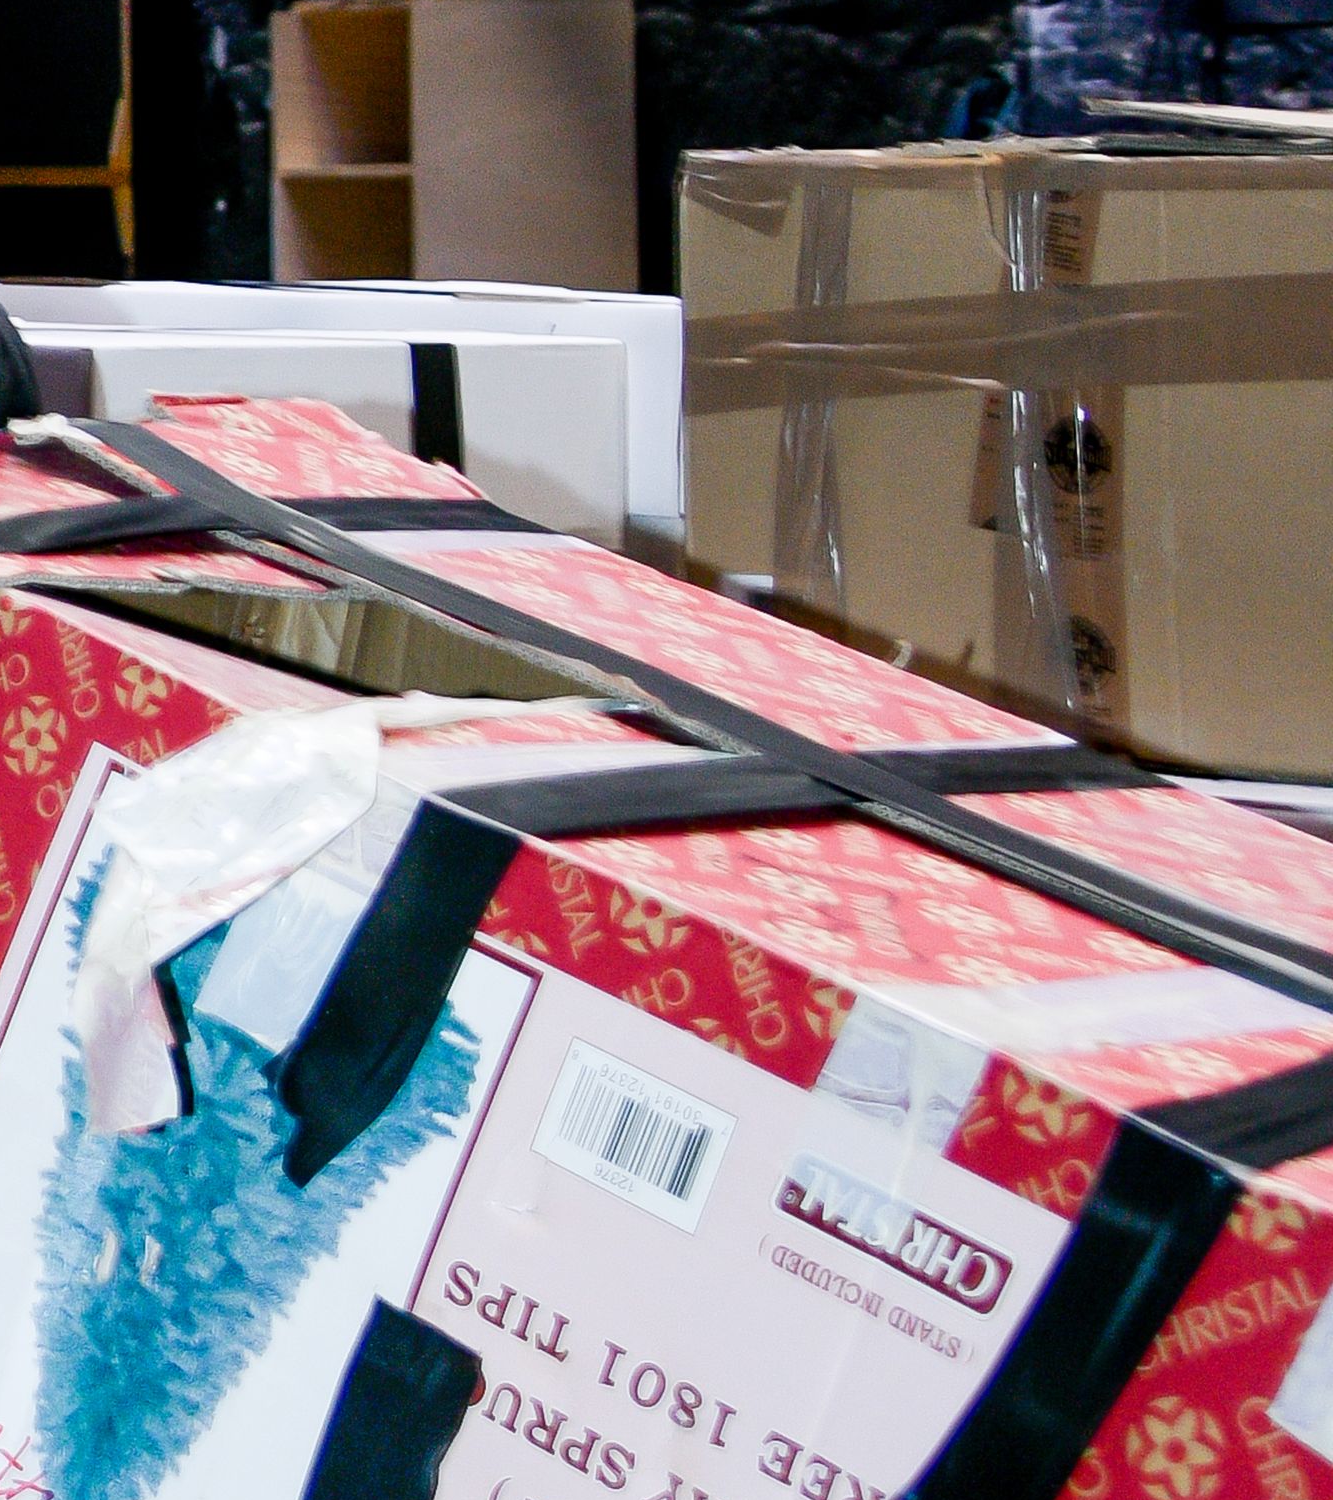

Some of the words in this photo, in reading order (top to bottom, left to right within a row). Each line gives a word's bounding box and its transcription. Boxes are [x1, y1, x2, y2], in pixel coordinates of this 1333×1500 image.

[593, 1161, 636, 1195] 12376
[442, 1258, 573, 1363] TIPS
[771, 1244, 884, 1320] INCLUDED
[888, 1303, 963, 1360] STAND
[598, 1338, 738, 1449] 1801
